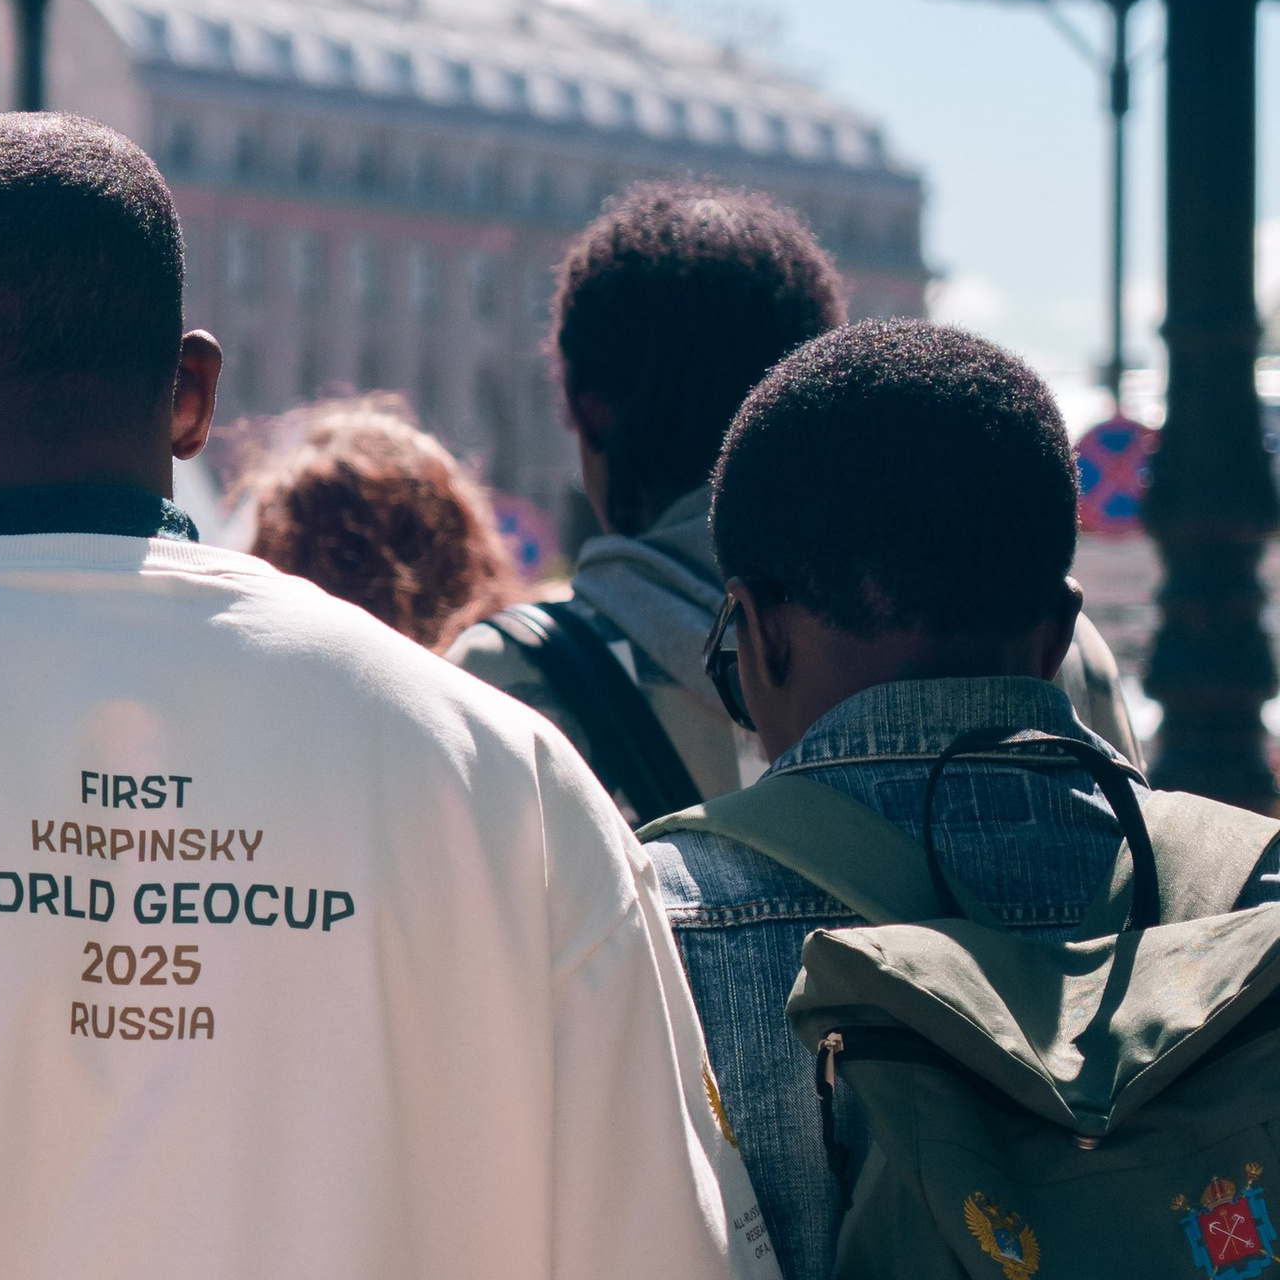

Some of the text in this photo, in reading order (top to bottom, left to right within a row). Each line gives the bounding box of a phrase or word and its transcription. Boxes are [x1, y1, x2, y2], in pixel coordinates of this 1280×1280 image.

[81, 770, 193, 810] FIRST
[30, 819, 264, 862] KARPINSKY
[132, 882, 356, 933] GEOCUP
[81, 941, 203, 986] 2025
[70, 1001, 216, 1041] RUSSIA
